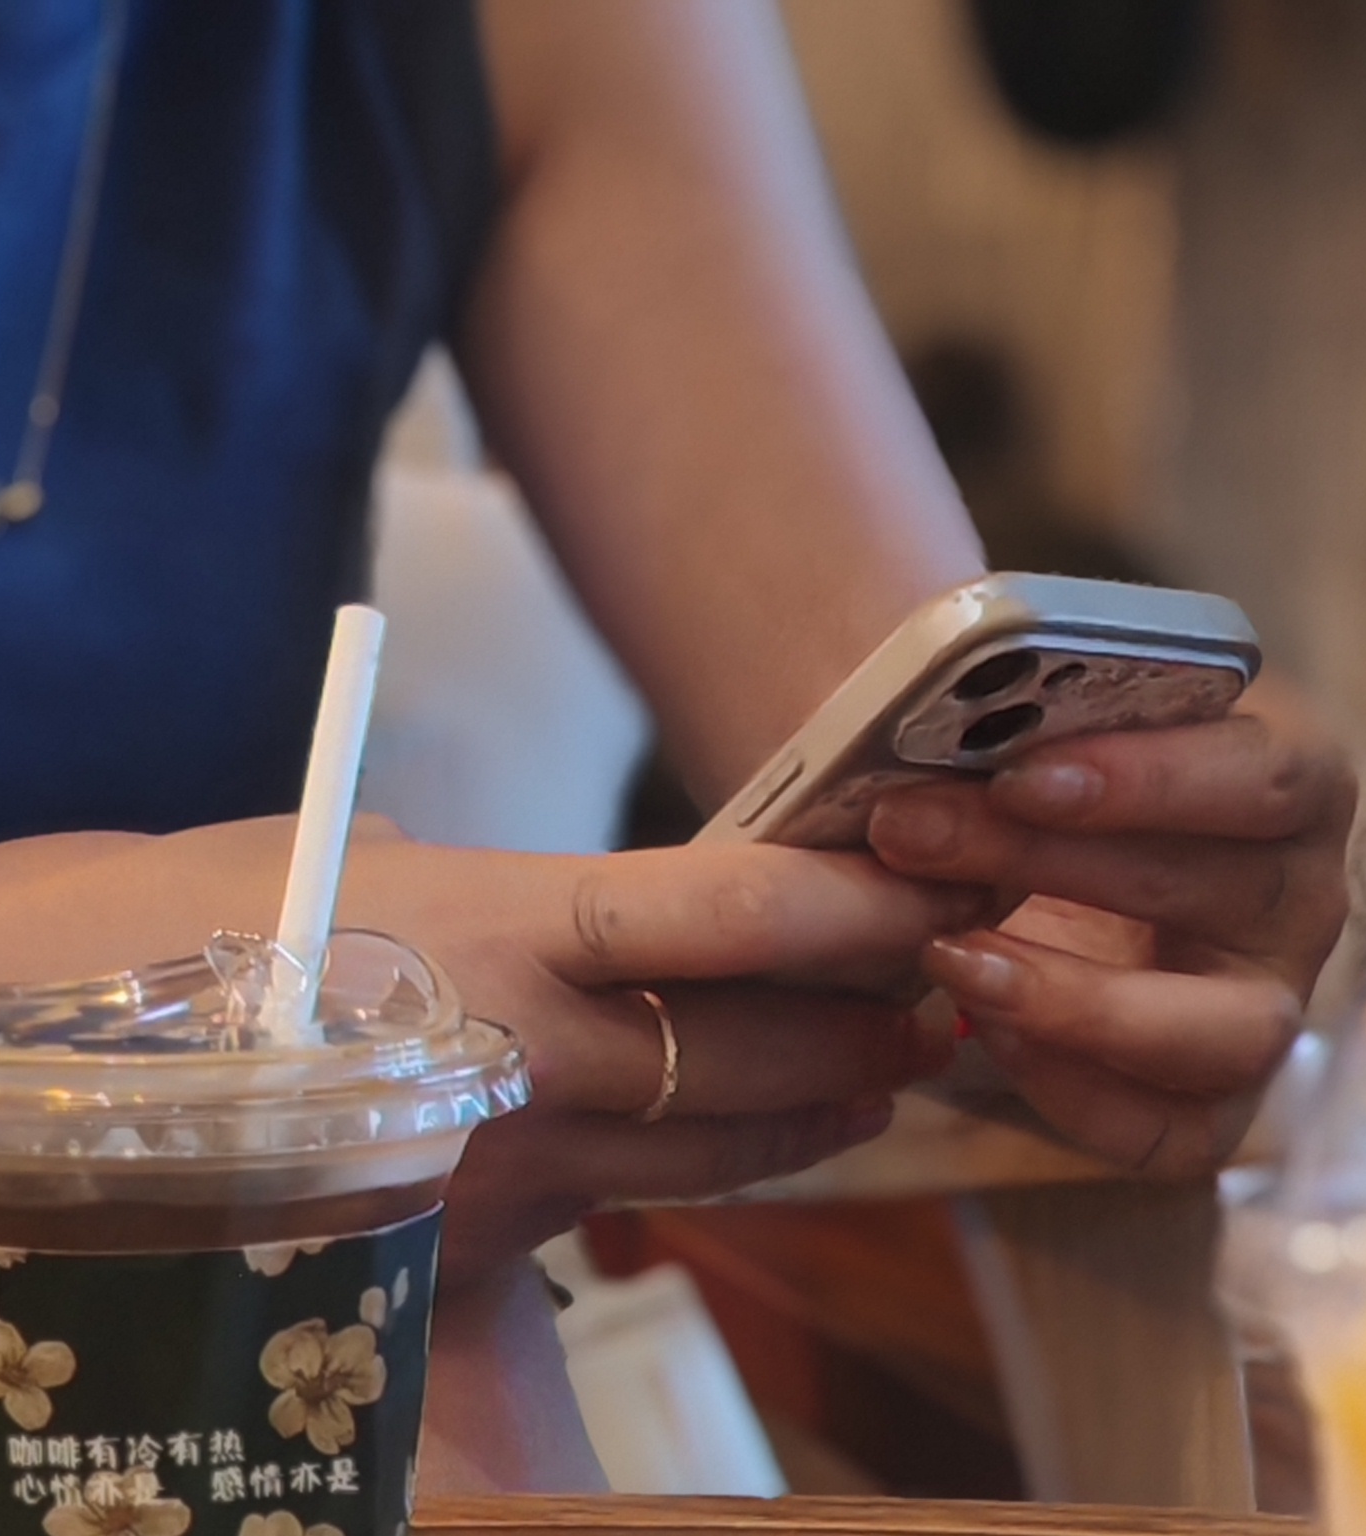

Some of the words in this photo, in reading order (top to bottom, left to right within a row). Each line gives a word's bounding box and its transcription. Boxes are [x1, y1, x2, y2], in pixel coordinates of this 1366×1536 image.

[7, 1429, 246, 1471] 咖啡有冷有热
